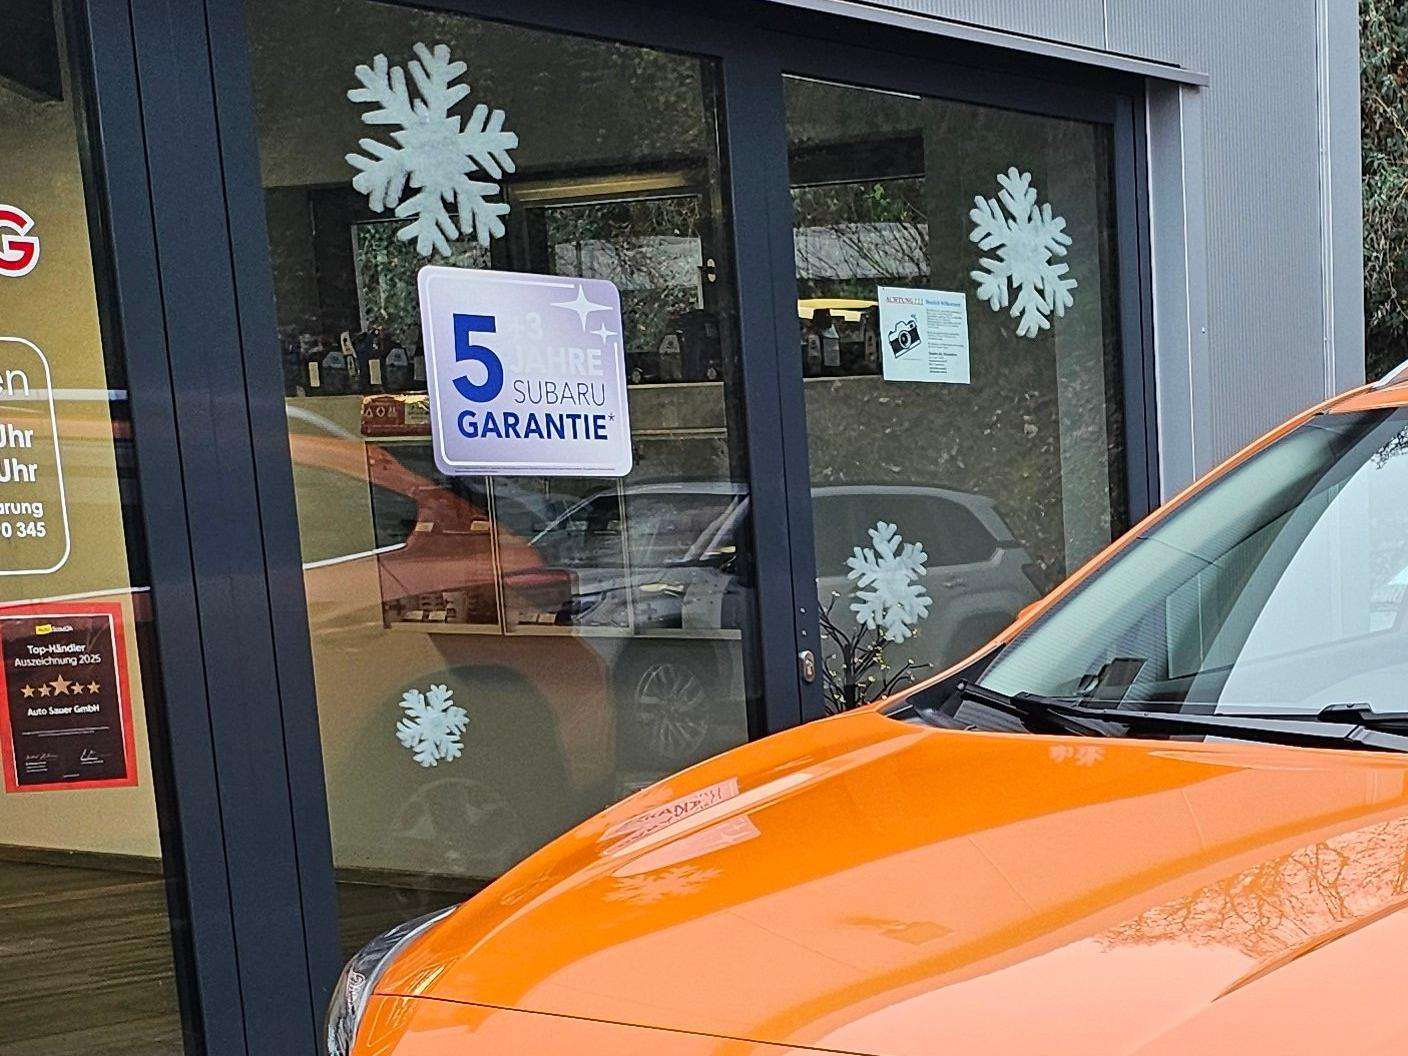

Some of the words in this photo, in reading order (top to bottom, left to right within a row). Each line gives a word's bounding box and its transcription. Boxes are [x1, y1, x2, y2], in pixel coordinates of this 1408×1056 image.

[452, 313, 504, 404] 5
[511, 343, 604, 376] JAHRE
[0, 369, 29, 396] n
[513, 379, 606, 407] SUBARU
[16, 521, 47, 538] 345
[14, 655, 78, 667] Auszeichnung
[79, 653, 102, 665] 2025
[26, 643, 86, 655] Top-Händler
[27, 707, 48, 717] Auto
[49, 705, 72, 716] Sauer
[73, 703, 100, 714] GmbH
